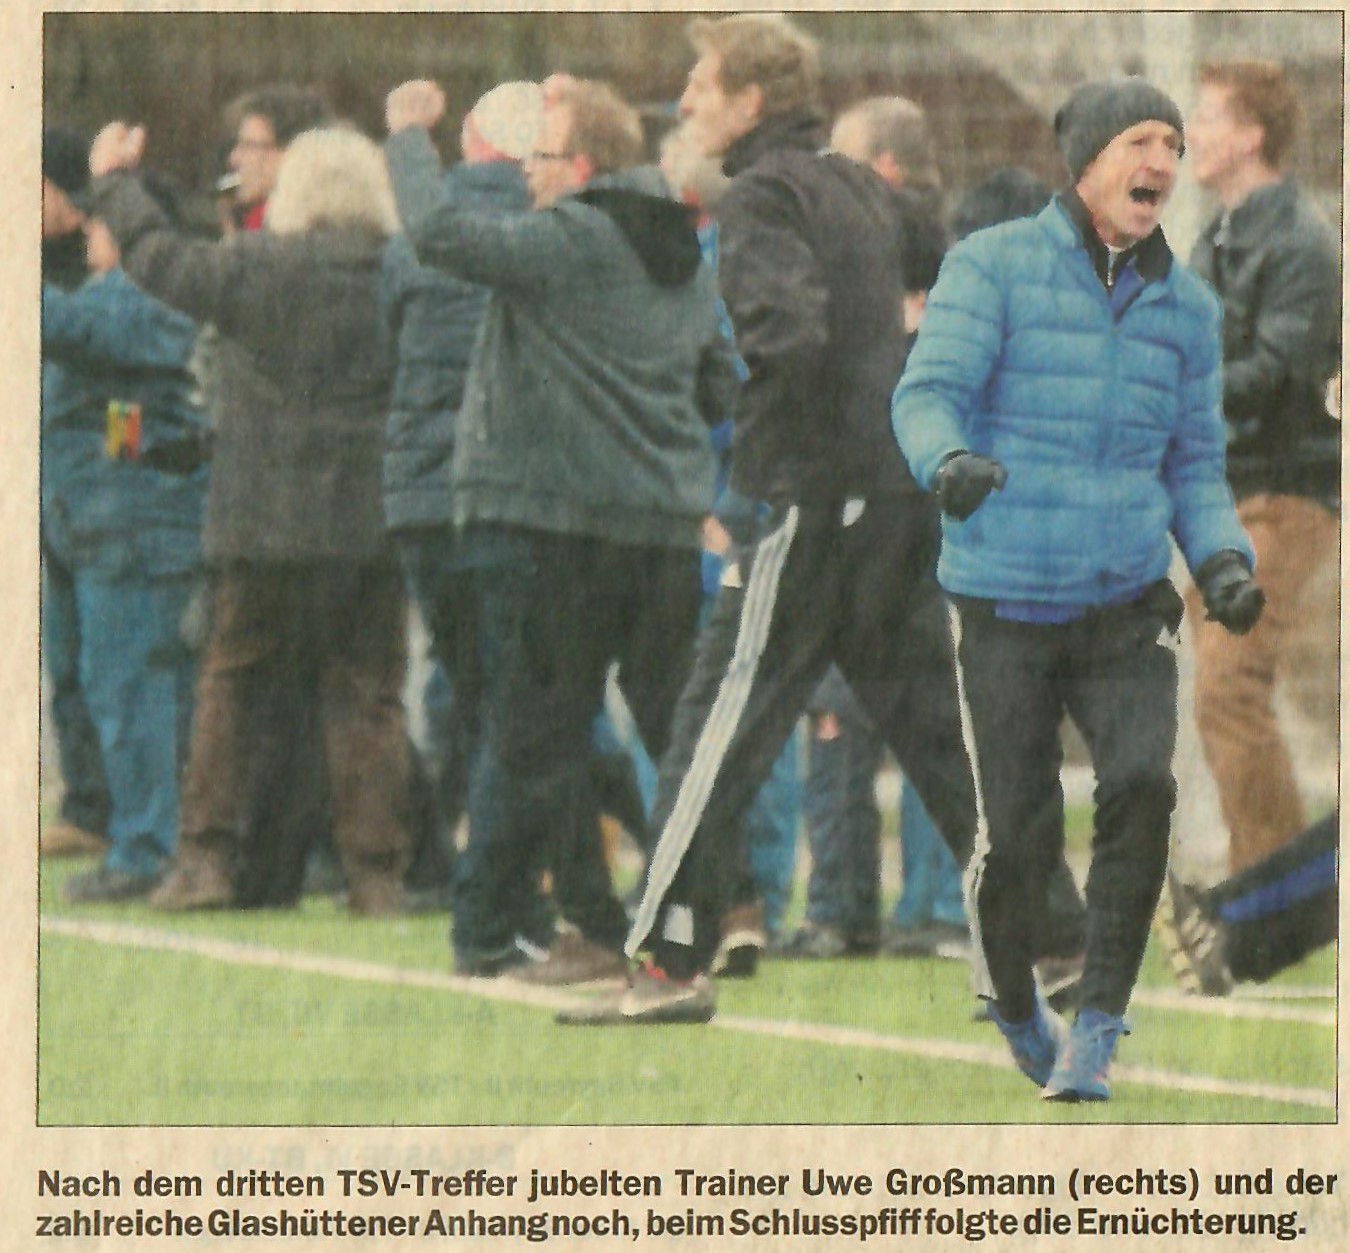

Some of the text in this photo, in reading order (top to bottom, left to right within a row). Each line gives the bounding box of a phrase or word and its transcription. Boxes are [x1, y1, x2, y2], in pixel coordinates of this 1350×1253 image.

[38, 1167, 1338, 1203] Nach dem dritten TSV-Treffer jubelten Trainer Uwe Großmann (rechts) und der
[36, 1207, 1306, 1242] zahlreiche Glashüttener Anhang noch, beim Schlusspfiff folgte die Ernüchterung.
